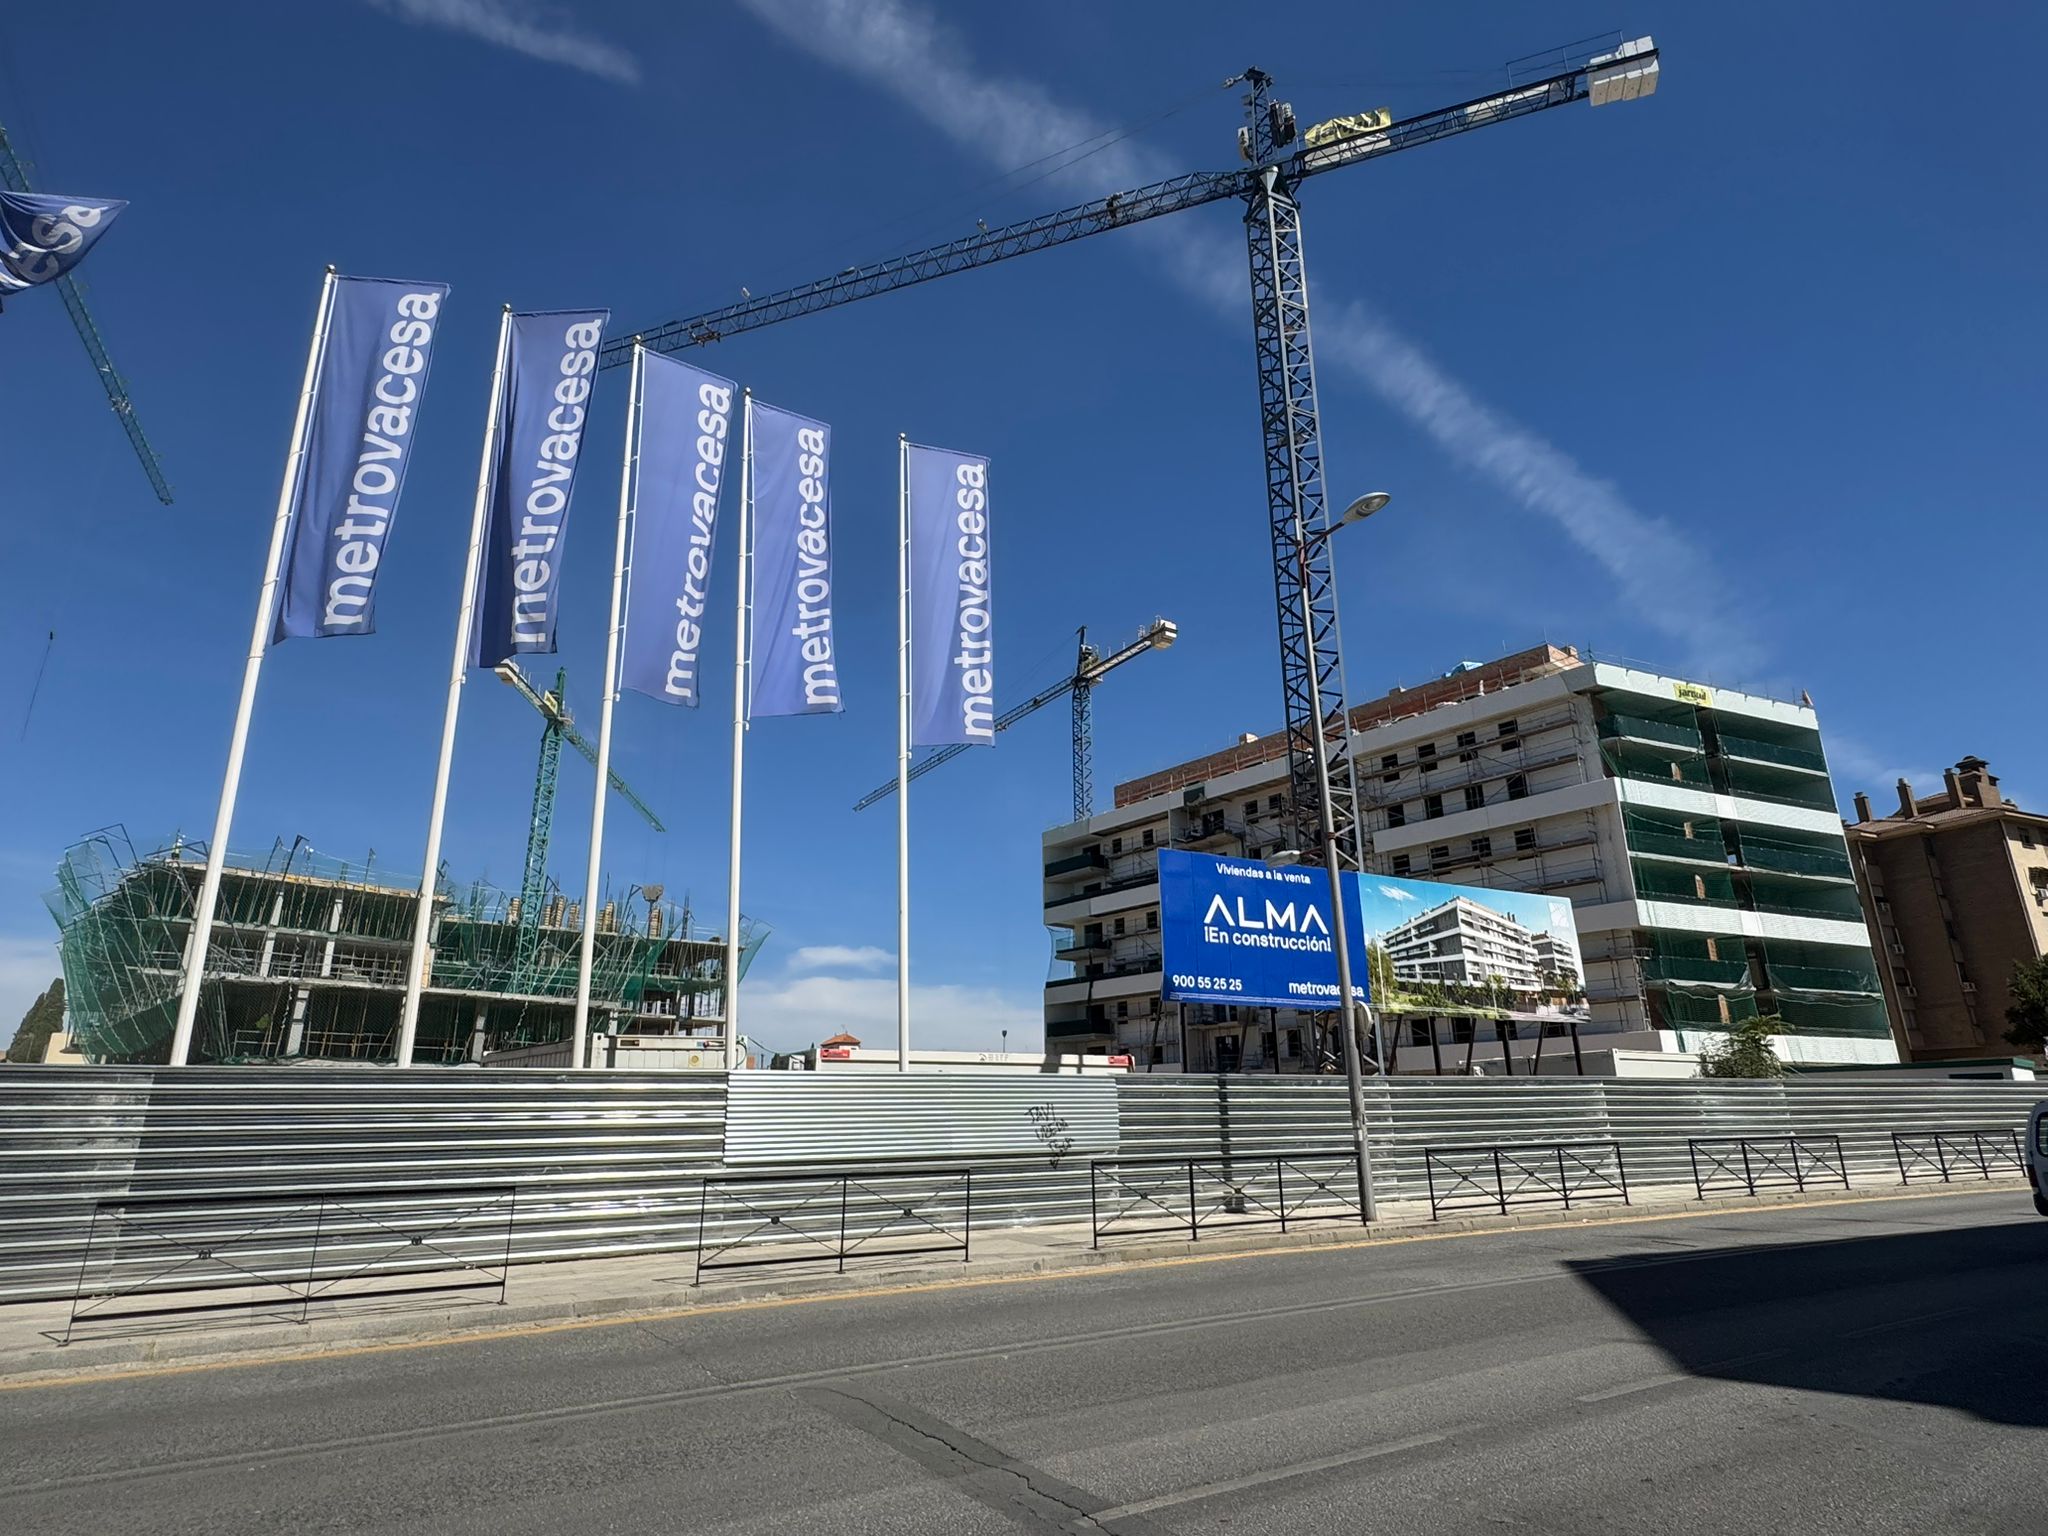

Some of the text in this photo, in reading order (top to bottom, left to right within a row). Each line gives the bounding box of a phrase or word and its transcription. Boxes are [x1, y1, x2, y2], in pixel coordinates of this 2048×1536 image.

[324, 292, 441, 626] metrovacesa
[510, 318, 602, 645] metrovacesa
[665, 382, 731, 698] metrovacesa
[792, 428, 838, 705] metrovacesa
[954, 463, 994, 737] metrovacesa
[1172, 974, 1242, 991] 900 55 25 25
[1203, 894, 1329, 935] ALMA
[1216, 863, 1311, 884] Viviendas a la venta
[1232, 931, 1332, 953] construcción!
